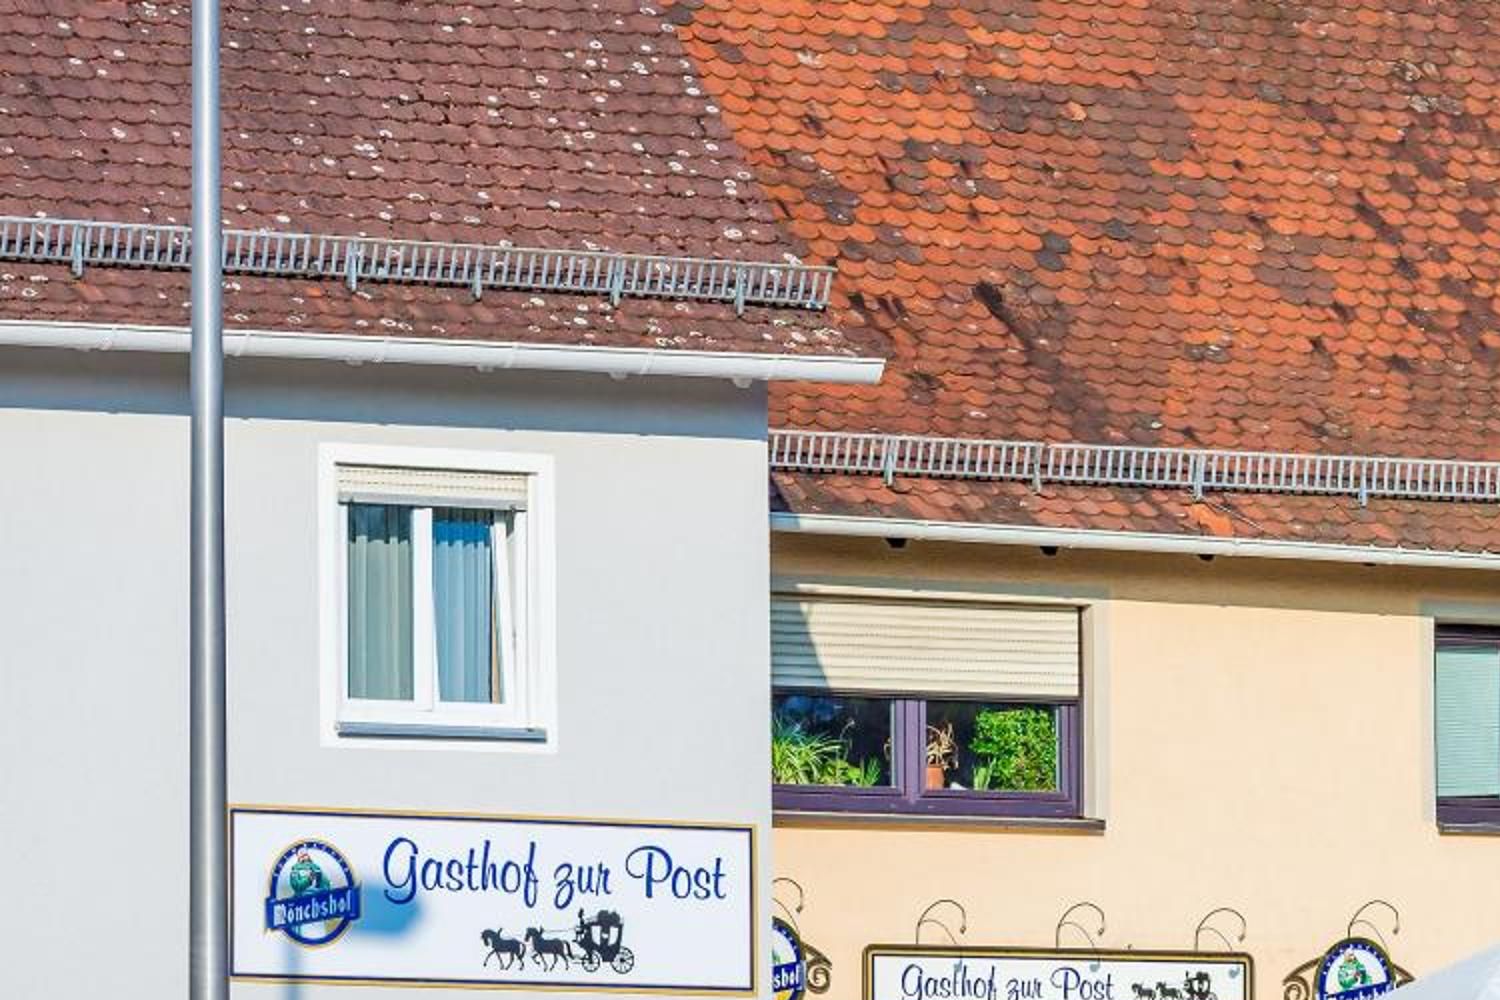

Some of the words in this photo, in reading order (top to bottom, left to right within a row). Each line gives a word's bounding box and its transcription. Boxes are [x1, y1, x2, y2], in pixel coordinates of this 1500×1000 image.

[383, 837, 539, 908] Gasthof
[553, 858, 613, 909] zur
[625, 845, 727, 901] Post
